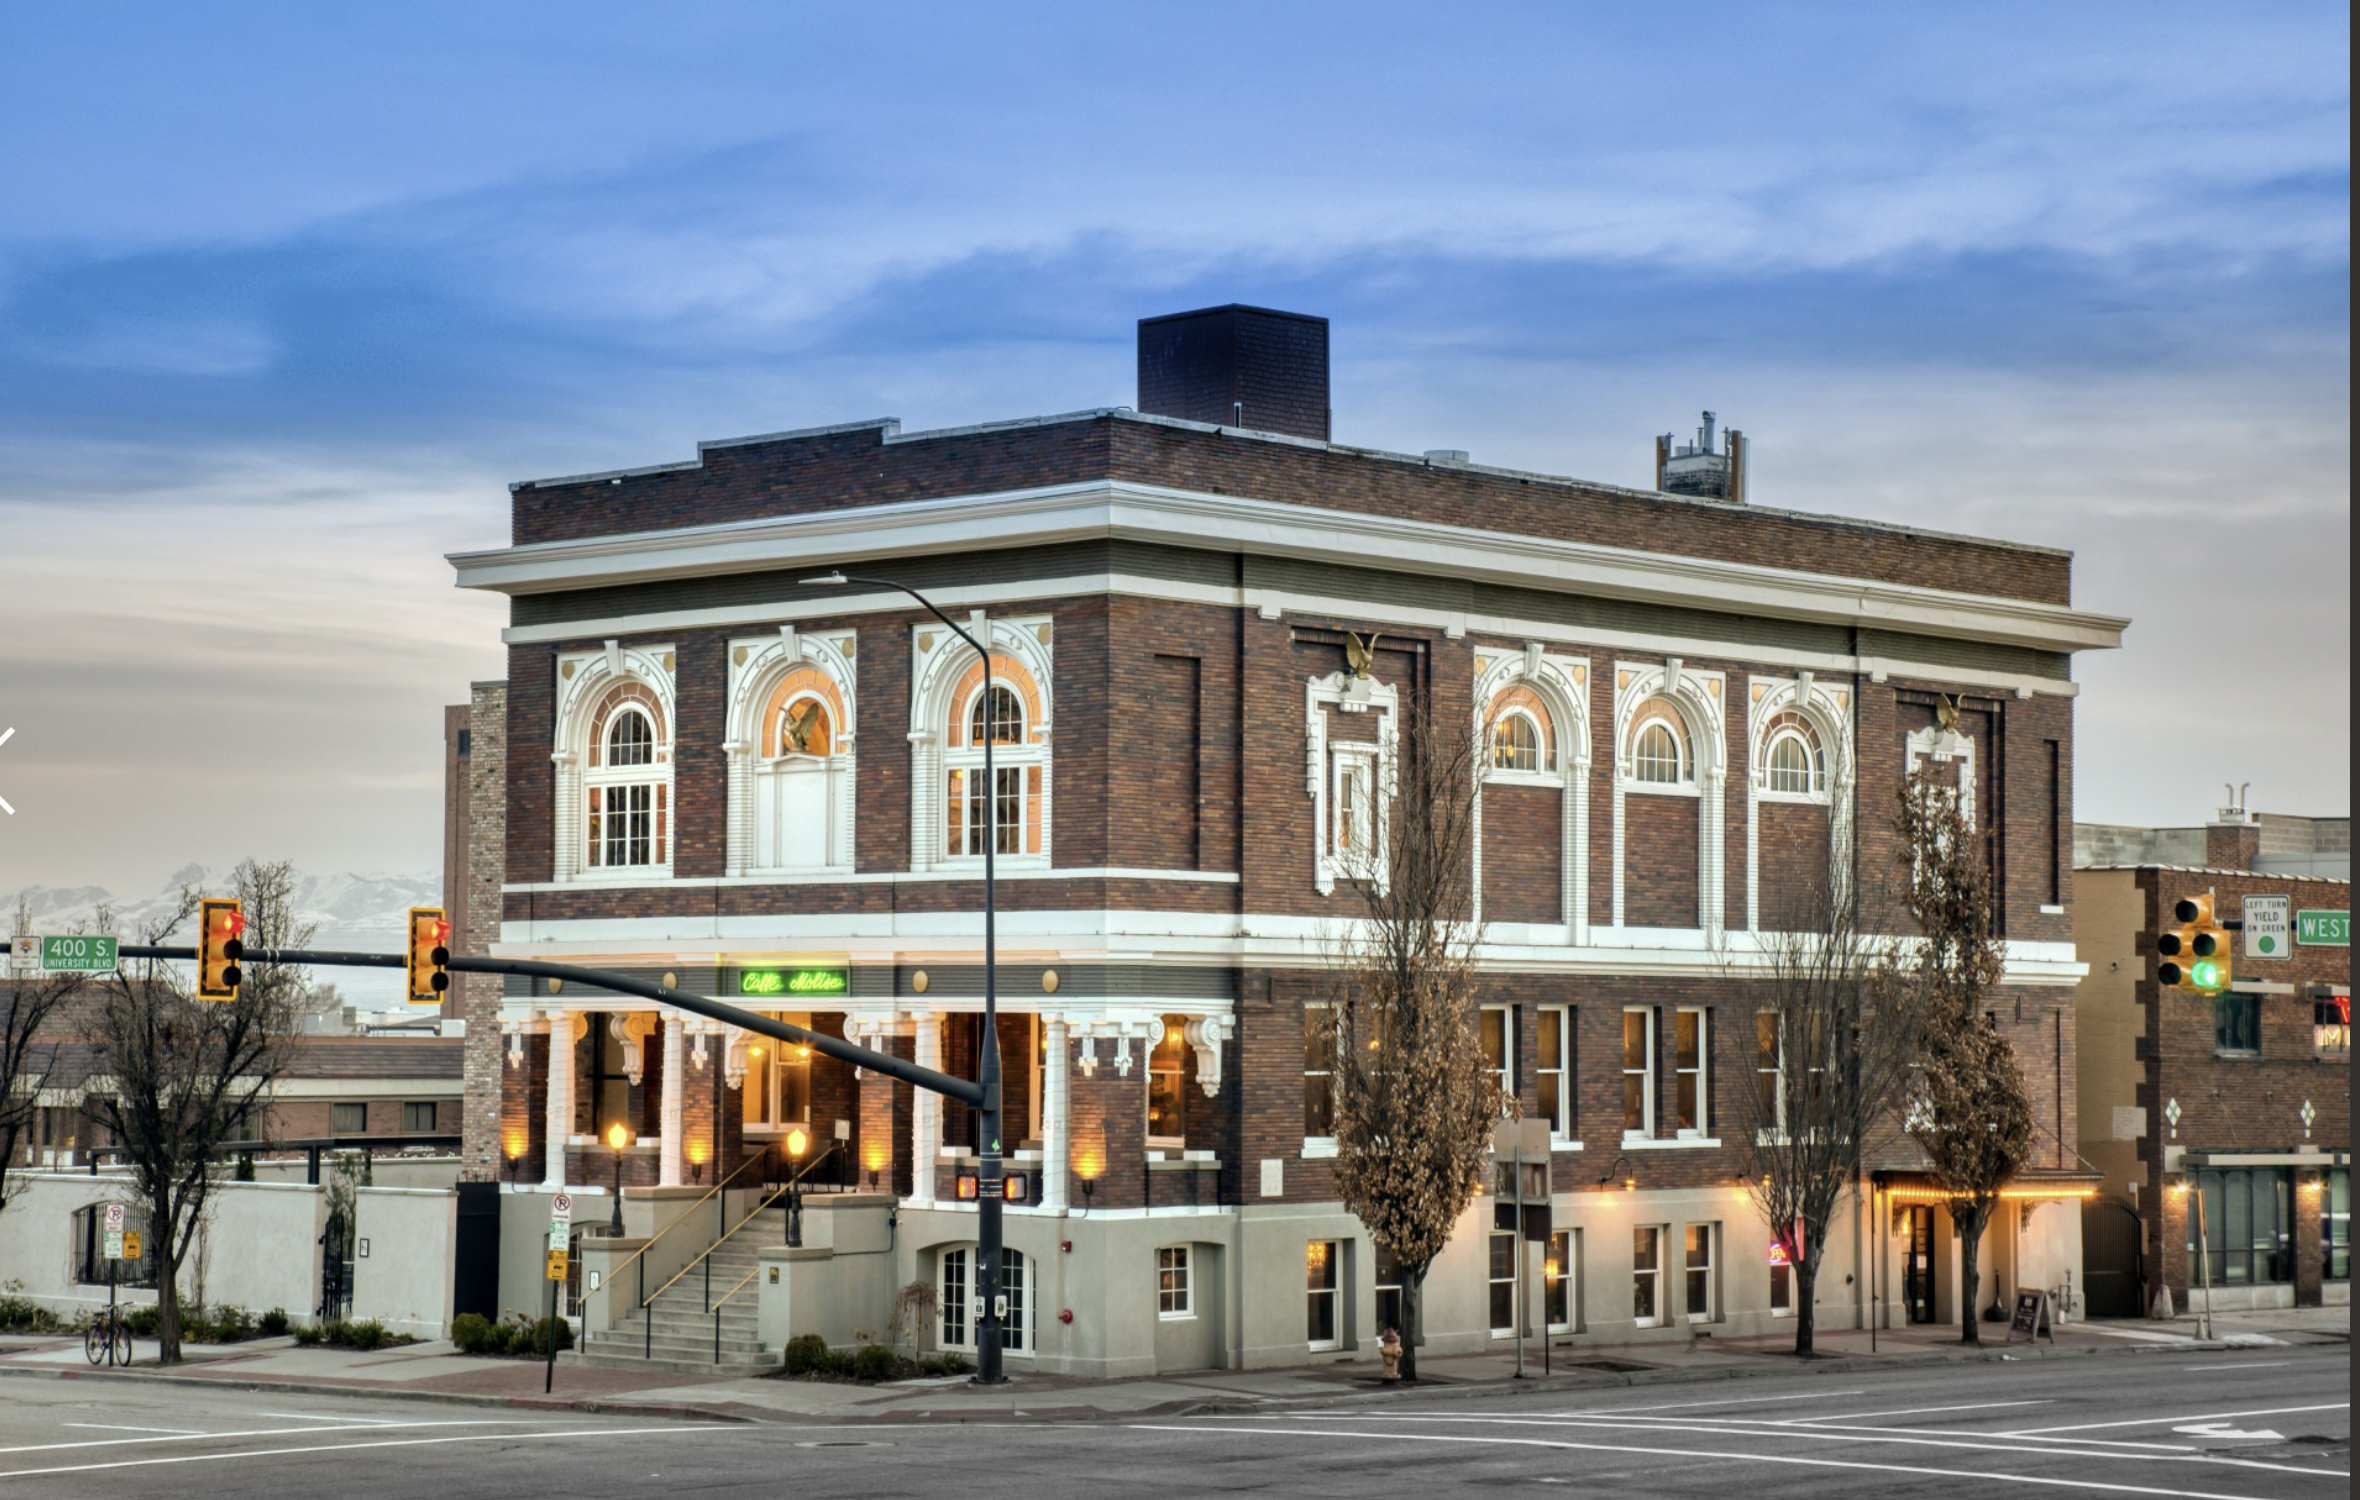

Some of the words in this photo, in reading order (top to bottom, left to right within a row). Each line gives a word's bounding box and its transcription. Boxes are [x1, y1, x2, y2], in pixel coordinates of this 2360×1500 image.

[2245, 901, 2263, 909] LEFT
[2267, 901, 2287, 909] TURN
[2254, 912, 2279, 922] YIELD
[2247, 925, 2257, 933] ON
[2261, 925, 2286, 933] GREEN
[2303, 919, 2350, 938] WEST
[50, 939, 86, 957] 400
[95, 940, 110, 957] S.
[44, 960, 90, 969] UNIVERSITY
[93, 960, 115, 969] BLVD.
[790, 973, 846, 990] Molise
